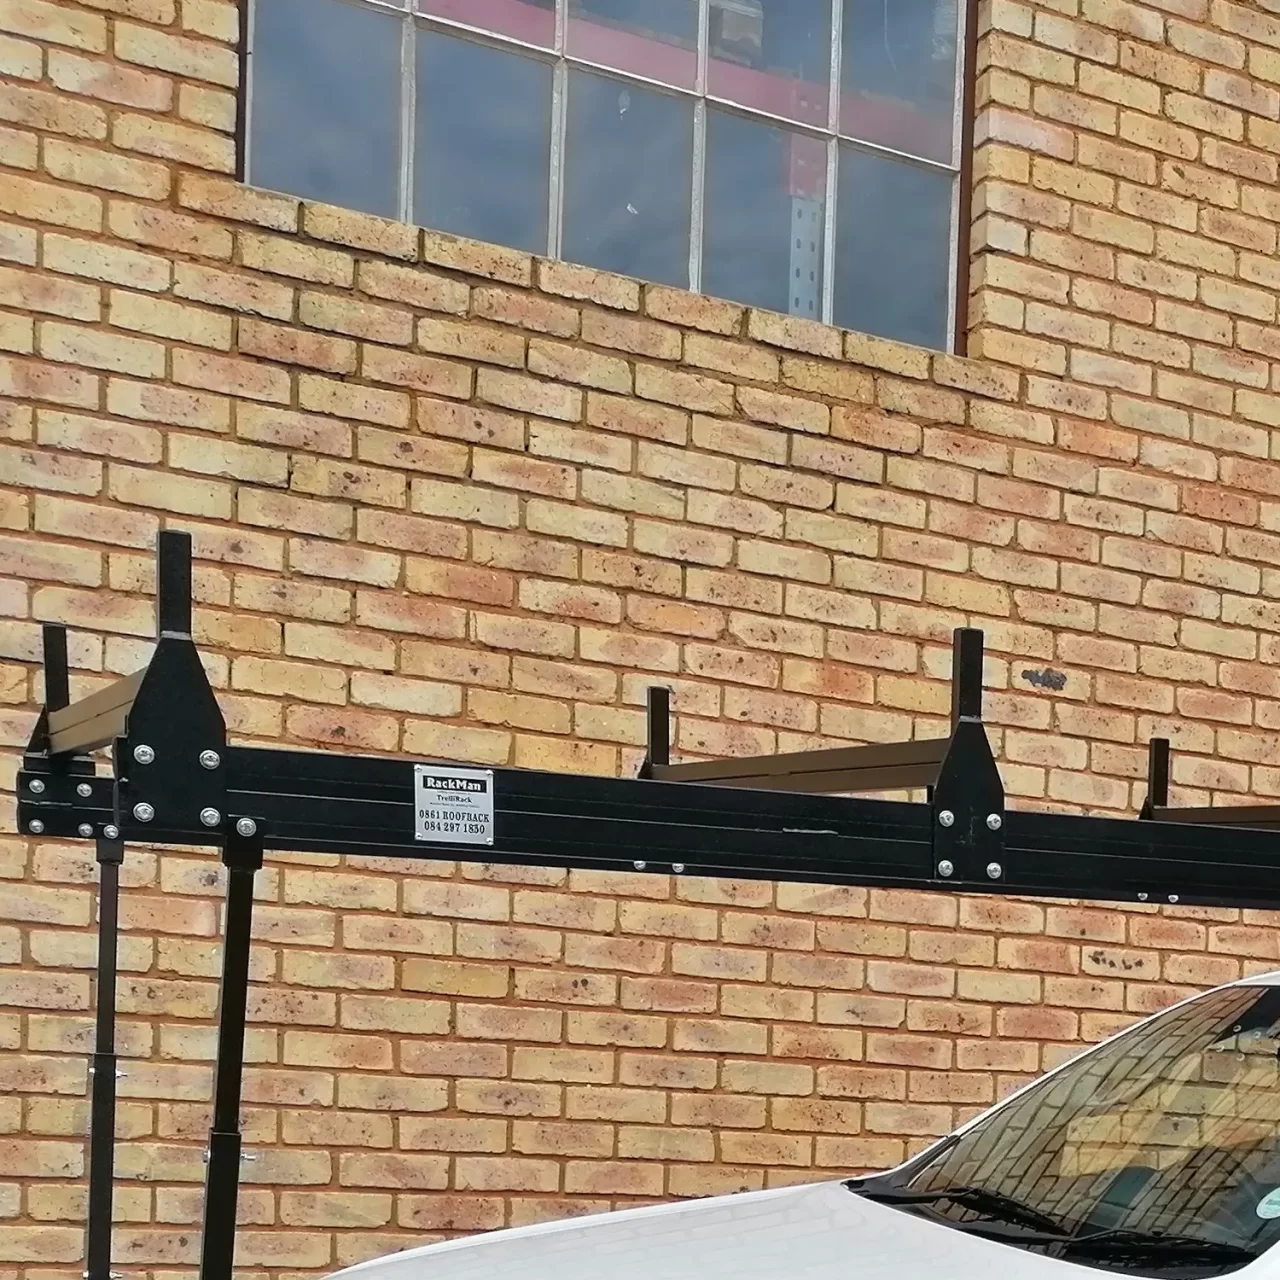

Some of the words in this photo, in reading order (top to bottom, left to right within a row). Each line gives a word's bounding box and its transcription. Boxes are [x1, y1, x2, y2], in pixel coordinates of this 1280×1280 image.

[427, 777, 481, 791] RackMan
[419, 809, 440, 819] 0861
[424, 821, 441, 832] 084
[443, 823, 460, 833] 297
